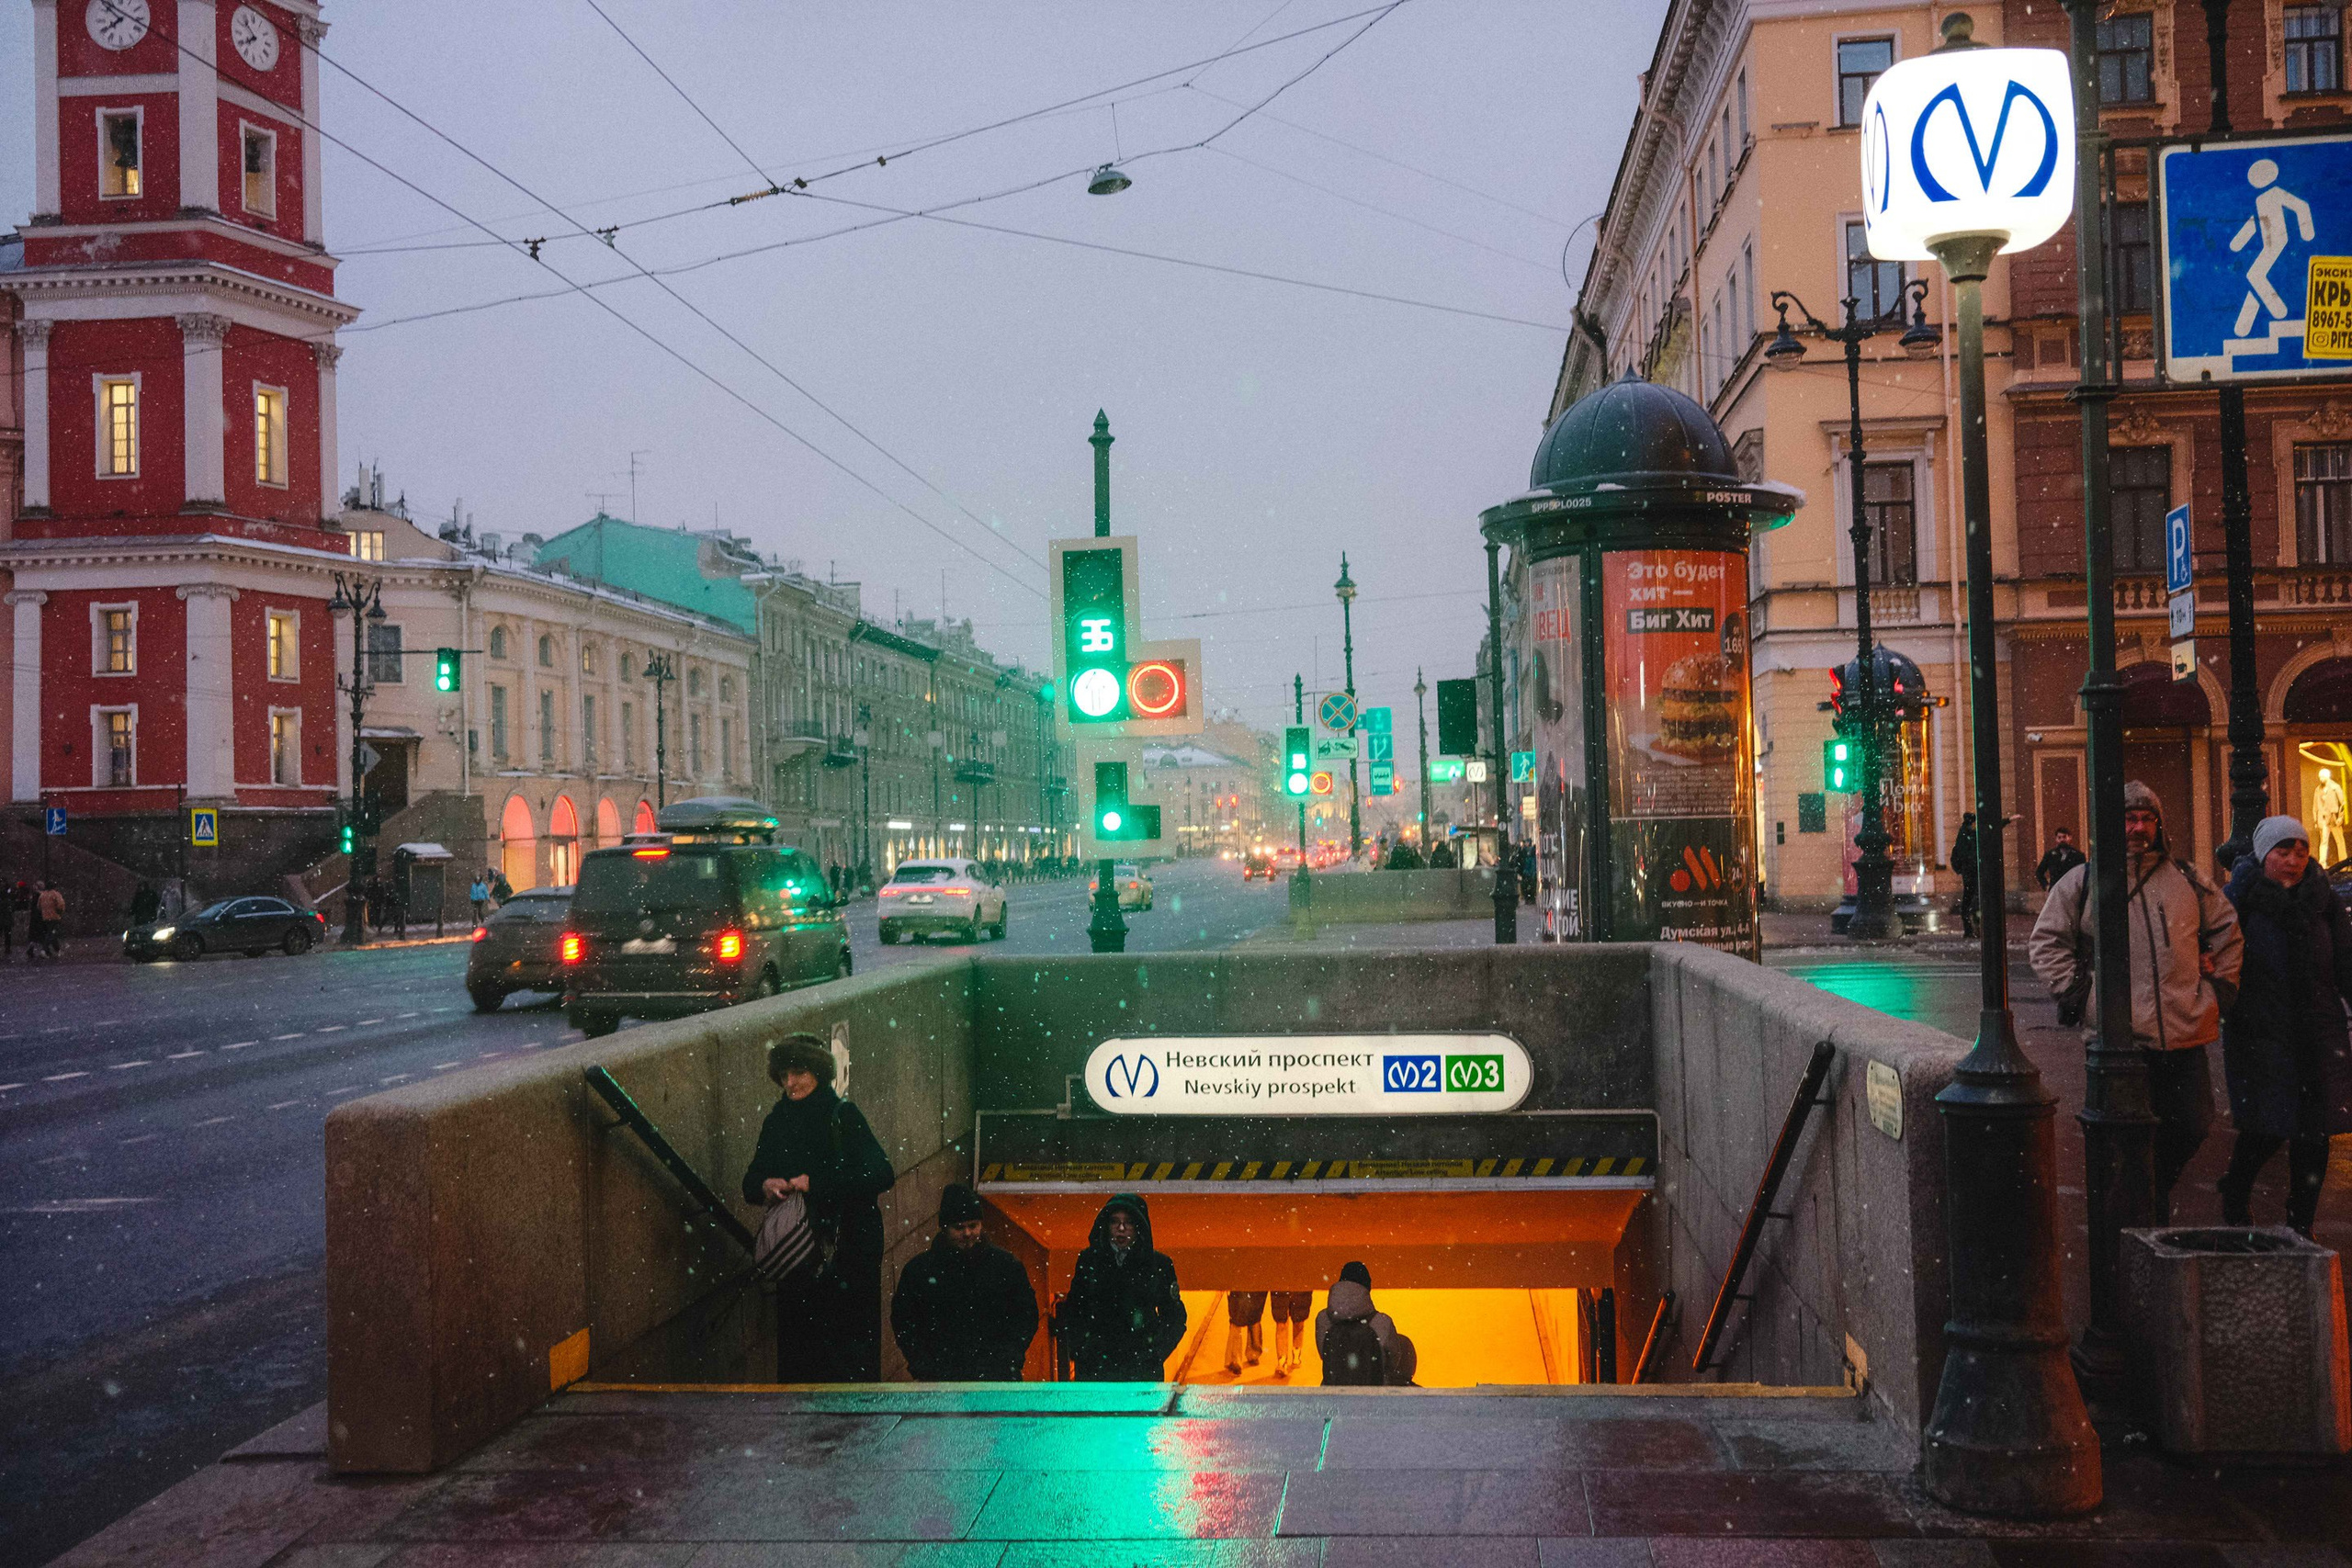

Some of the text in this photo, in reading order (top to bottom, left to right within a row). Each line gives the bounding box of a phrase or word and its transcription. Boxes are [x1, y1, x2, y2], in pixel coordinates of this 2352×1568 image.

[1707, 491, 1752, 503] POSTER
[2172, 517, 2186, 582] P
[1628, 560, 1725, 582] Это будет
[1629, 586, 1670, 602] хит
[1630, 609, 1712, 630] Биг Хит
[1080, 618, 1114, 652] 36
[1660, 926, 1718, 941] Думская
[1166, 1049, 1374, 1073] Невский проспект
[1184, 1077, 1357, 1098] Nevskiy prospekt
